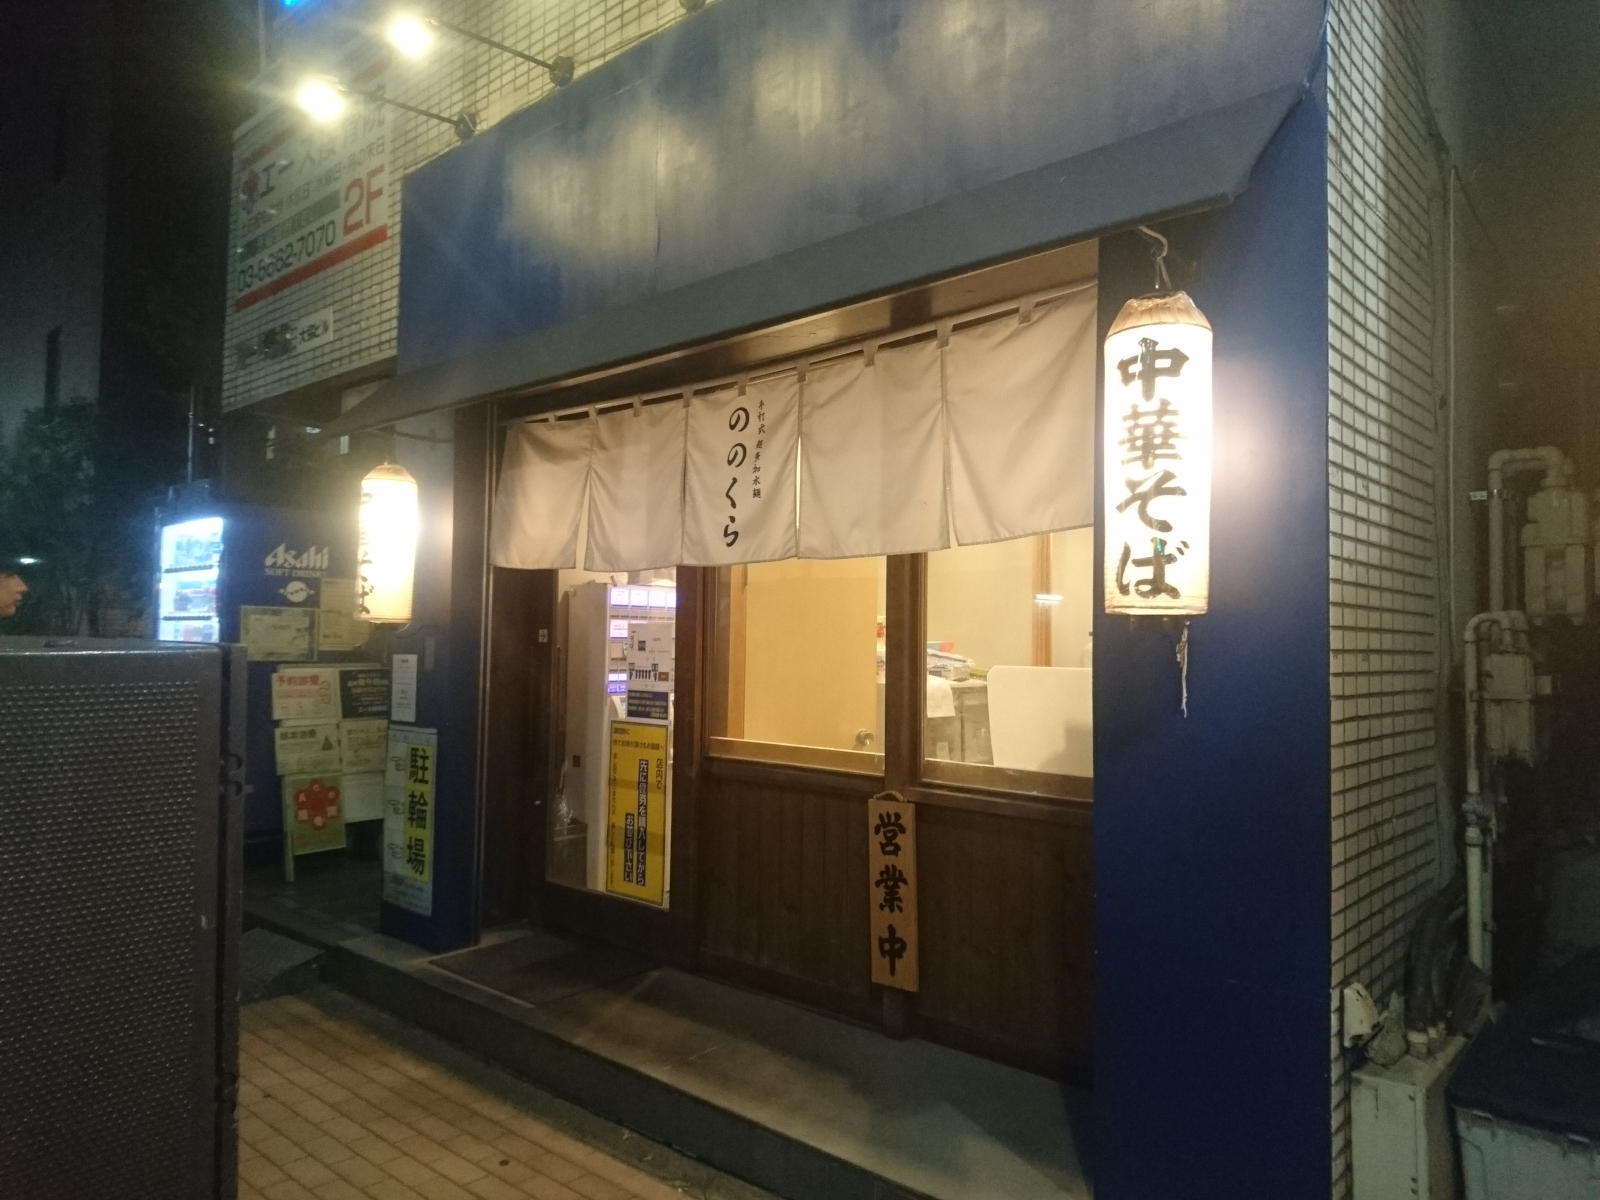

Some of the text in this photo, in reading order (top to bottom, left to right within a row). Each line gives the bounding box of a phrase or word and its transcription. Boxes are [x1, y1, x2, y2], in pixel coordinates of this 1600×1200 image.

[342, 162, 386, 237] 2F
[723, 407, 750, 548] ののくら
[1115, 337, 1190, 600] 中華そば
[265, 542, 329, 570] Asahi
[407, 747, 430, 876] 駐輪場
[655, 758, 664, 790] 店内で
[624, 814, 635, 882] お並び下さい
[874, 811, 909, 978] 営業中
